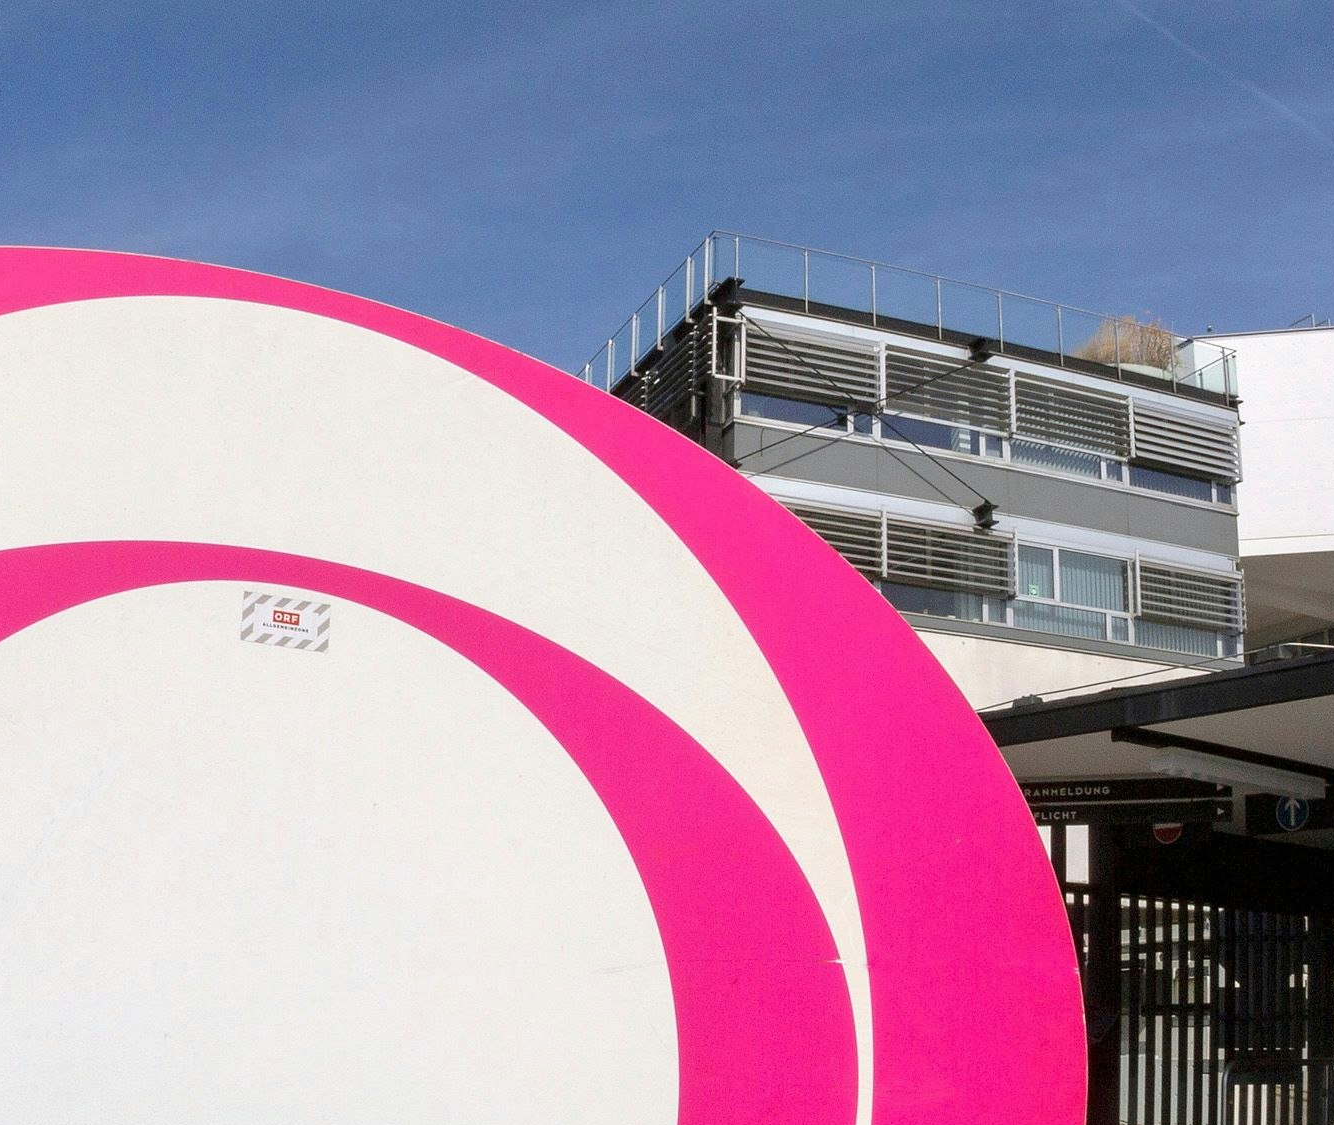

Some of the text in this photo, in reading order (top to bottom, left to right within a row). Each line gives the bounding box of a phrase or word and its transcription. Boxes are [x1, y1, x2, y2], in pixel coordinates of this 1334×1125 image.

[274, 611, 299, 624] ORF
[1024, 786, 1110, 796] RANMELDUNG
[1034, 811, 1077, 821] FLICHT
